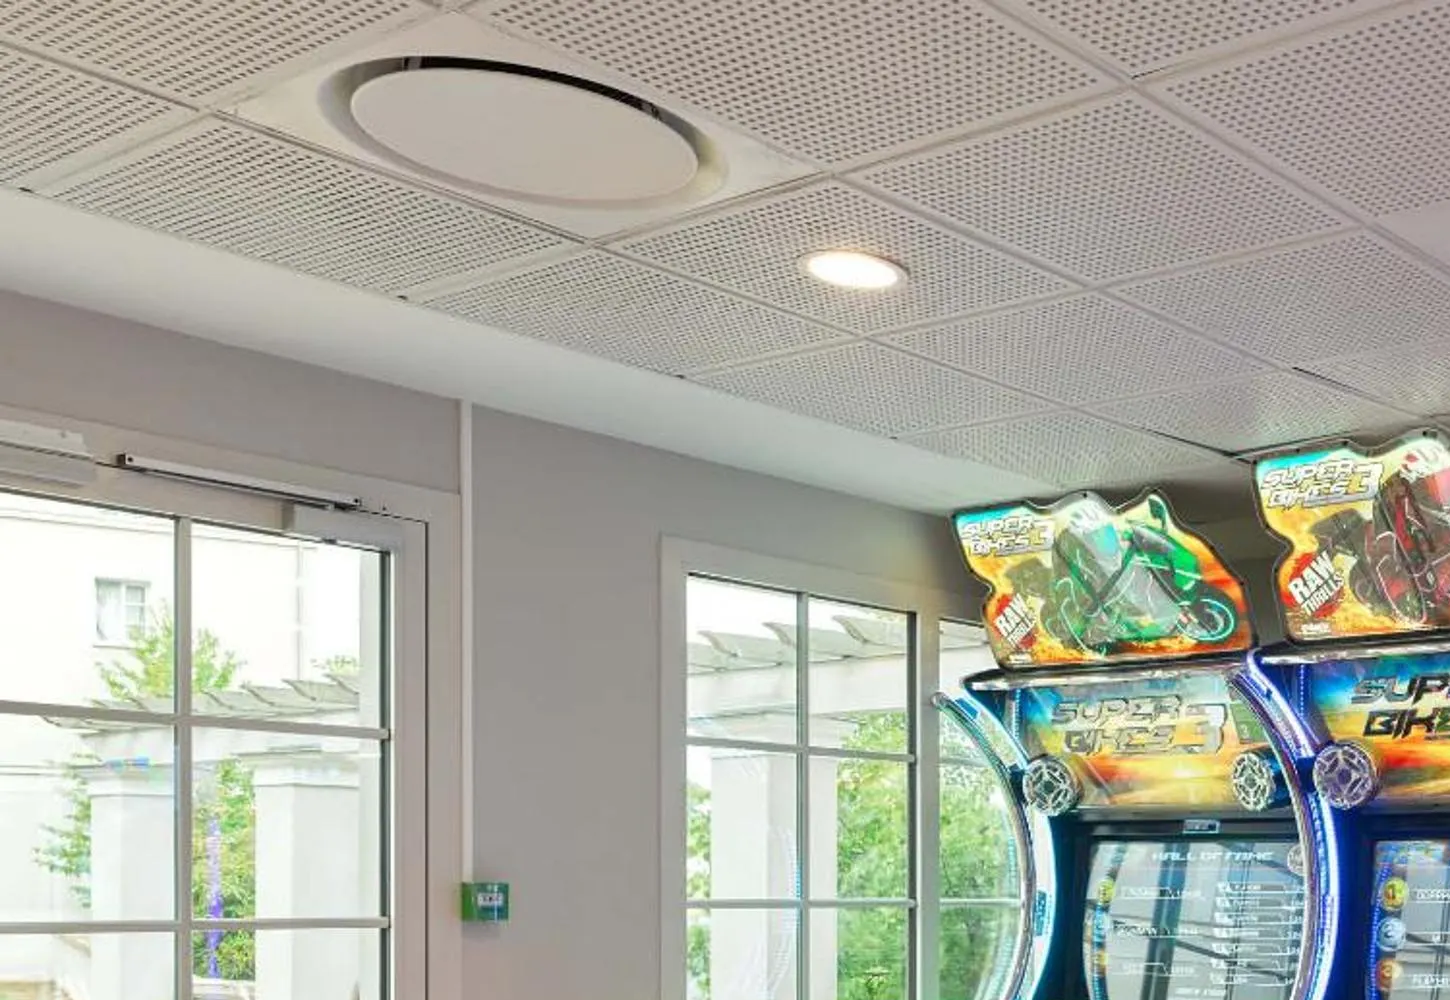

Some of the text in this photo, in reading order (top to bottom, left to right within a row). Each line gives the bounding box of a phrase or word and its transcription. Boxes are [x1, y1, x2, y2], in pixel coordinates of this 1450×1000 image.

[1261, 459, 1353, 488] SUPER
[1266, 479, 1350, 509] BIKES
[960, 515, 1034, 538] SUPER
[1289, 550, 1336, 605] RAW
[993, 593, 1028, 638] RAW
[1051, 694, 1182, 724] SUPER
[1064, 725, 1178, 757] BIKES
